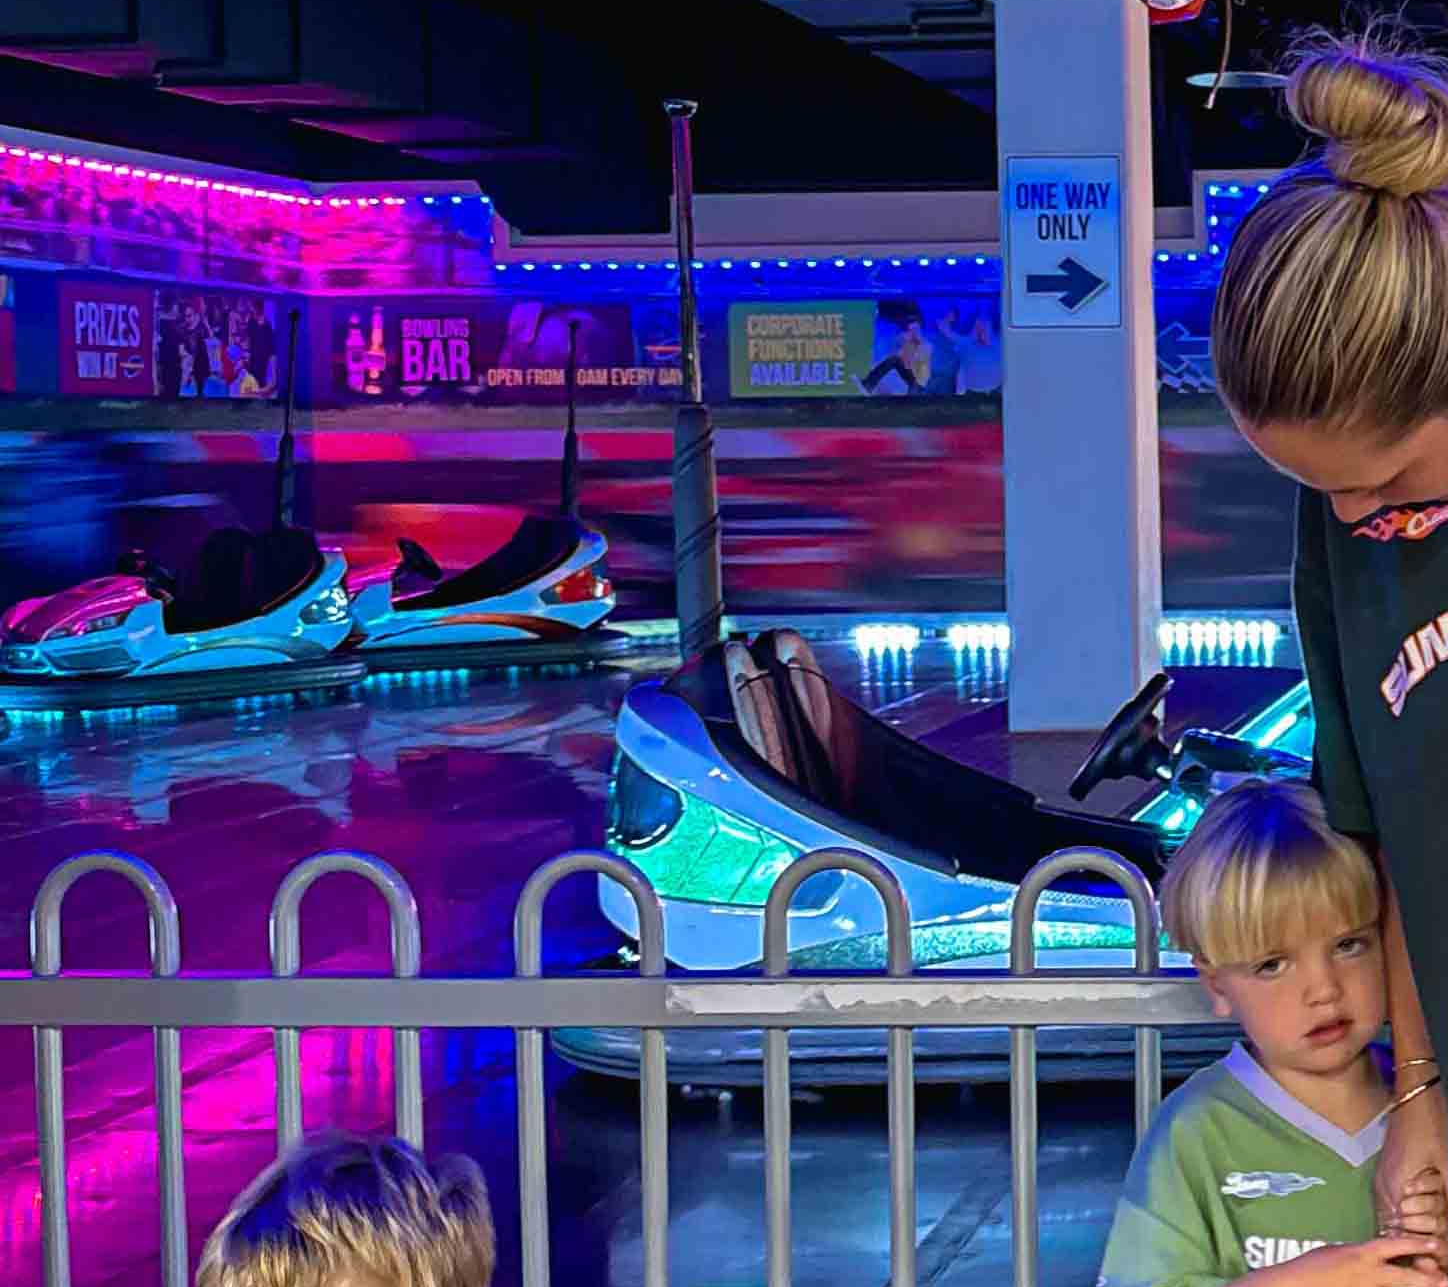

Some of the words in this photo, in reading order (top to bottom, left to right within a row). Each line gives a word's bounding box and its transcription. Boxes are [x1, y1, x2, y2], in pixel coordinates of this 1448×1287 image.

[1015, 183, 1057, 210] ONE
[1064, 182, 1111, 210] WAY
[1037, 214, 1091, 241] ONLY
[74, 300, 142, 348] PRIZES
[401, 318, 470, 339] BOWLING
[402, 339, 471, 382] BAR
[748, 337, 845, 360] FUNCTIONS
[487, 368, 523, 387] OPEN
[526, 368, 566, 387] FROM
[610, 368, 655, 386] EVERY
[749, 361, 844, 385] AVAILABLE
